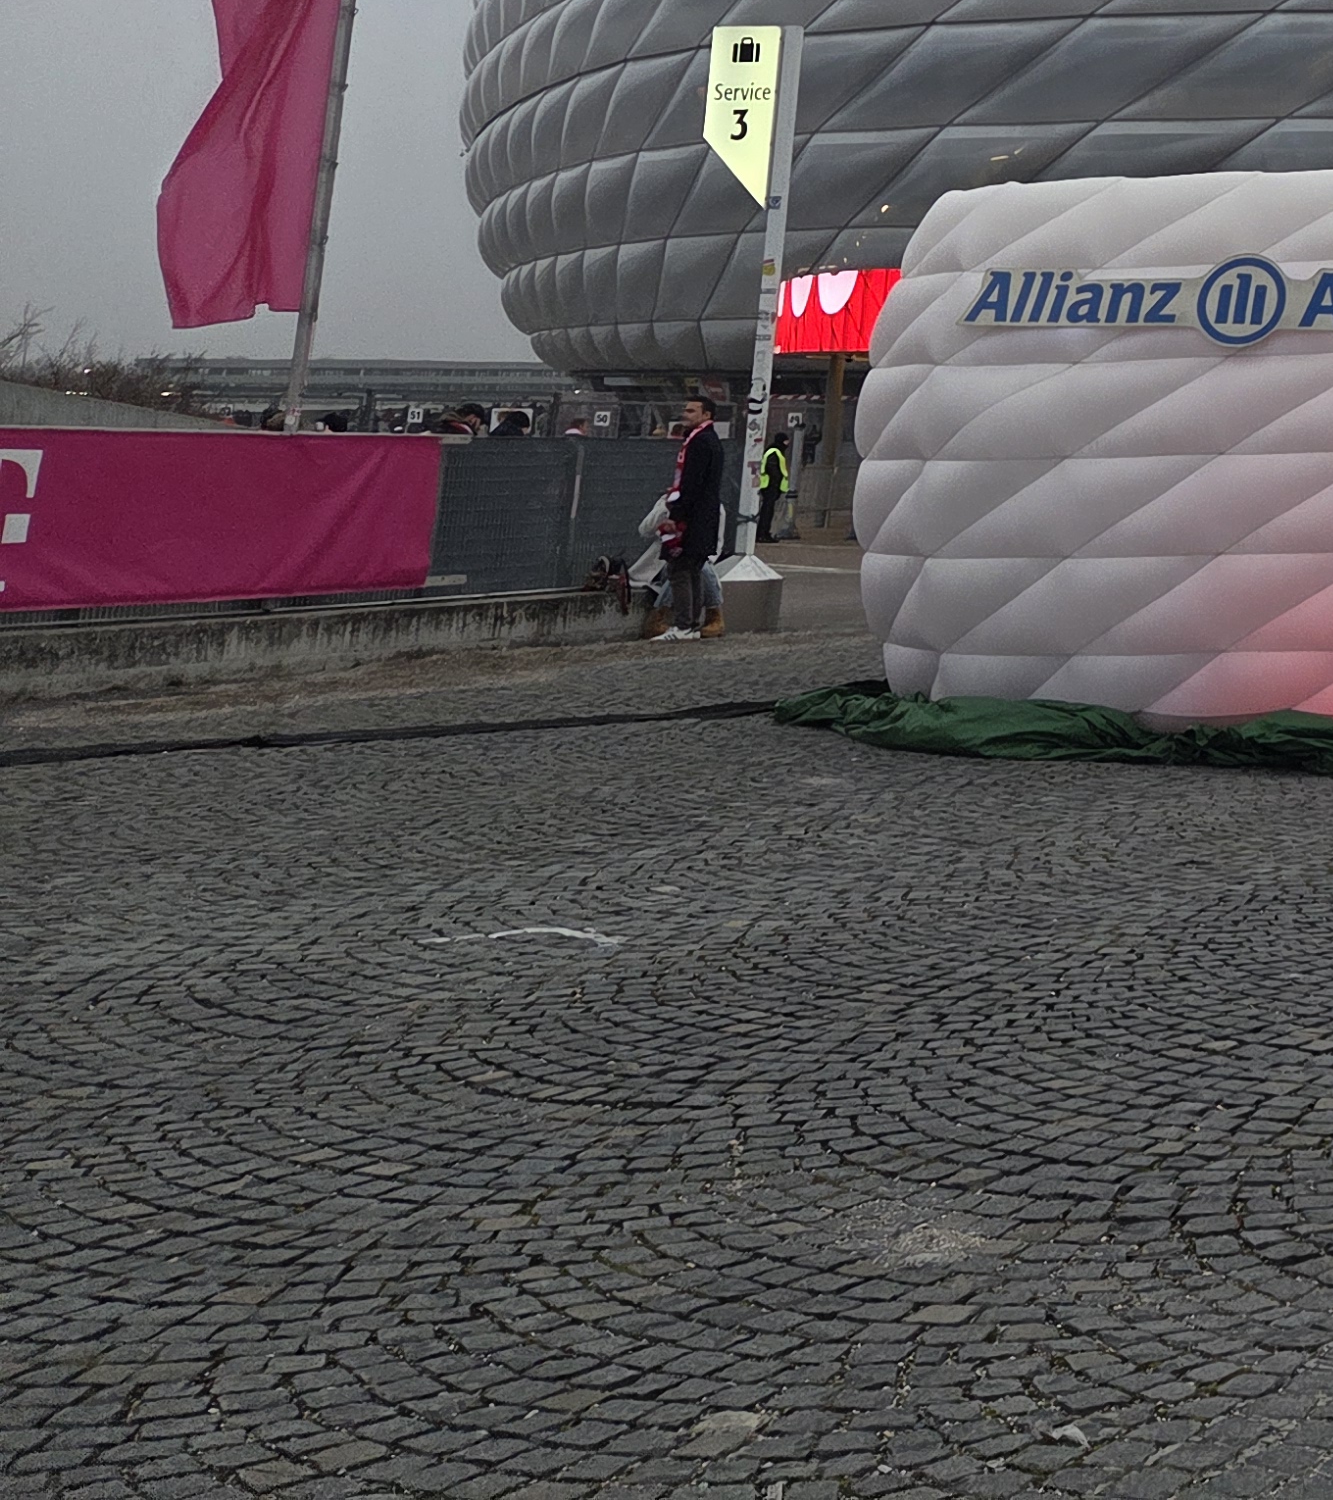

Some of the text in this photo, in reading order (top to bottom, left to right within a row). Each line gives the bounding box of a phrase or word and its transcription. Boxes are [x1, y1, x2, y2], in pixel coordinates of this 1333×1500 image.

[714, 82, 771, 101] Service
[730, 108, 749, 141] 3
[963, 270, 1183, 325] Allianz
[410, 410, 421, 421] 51
